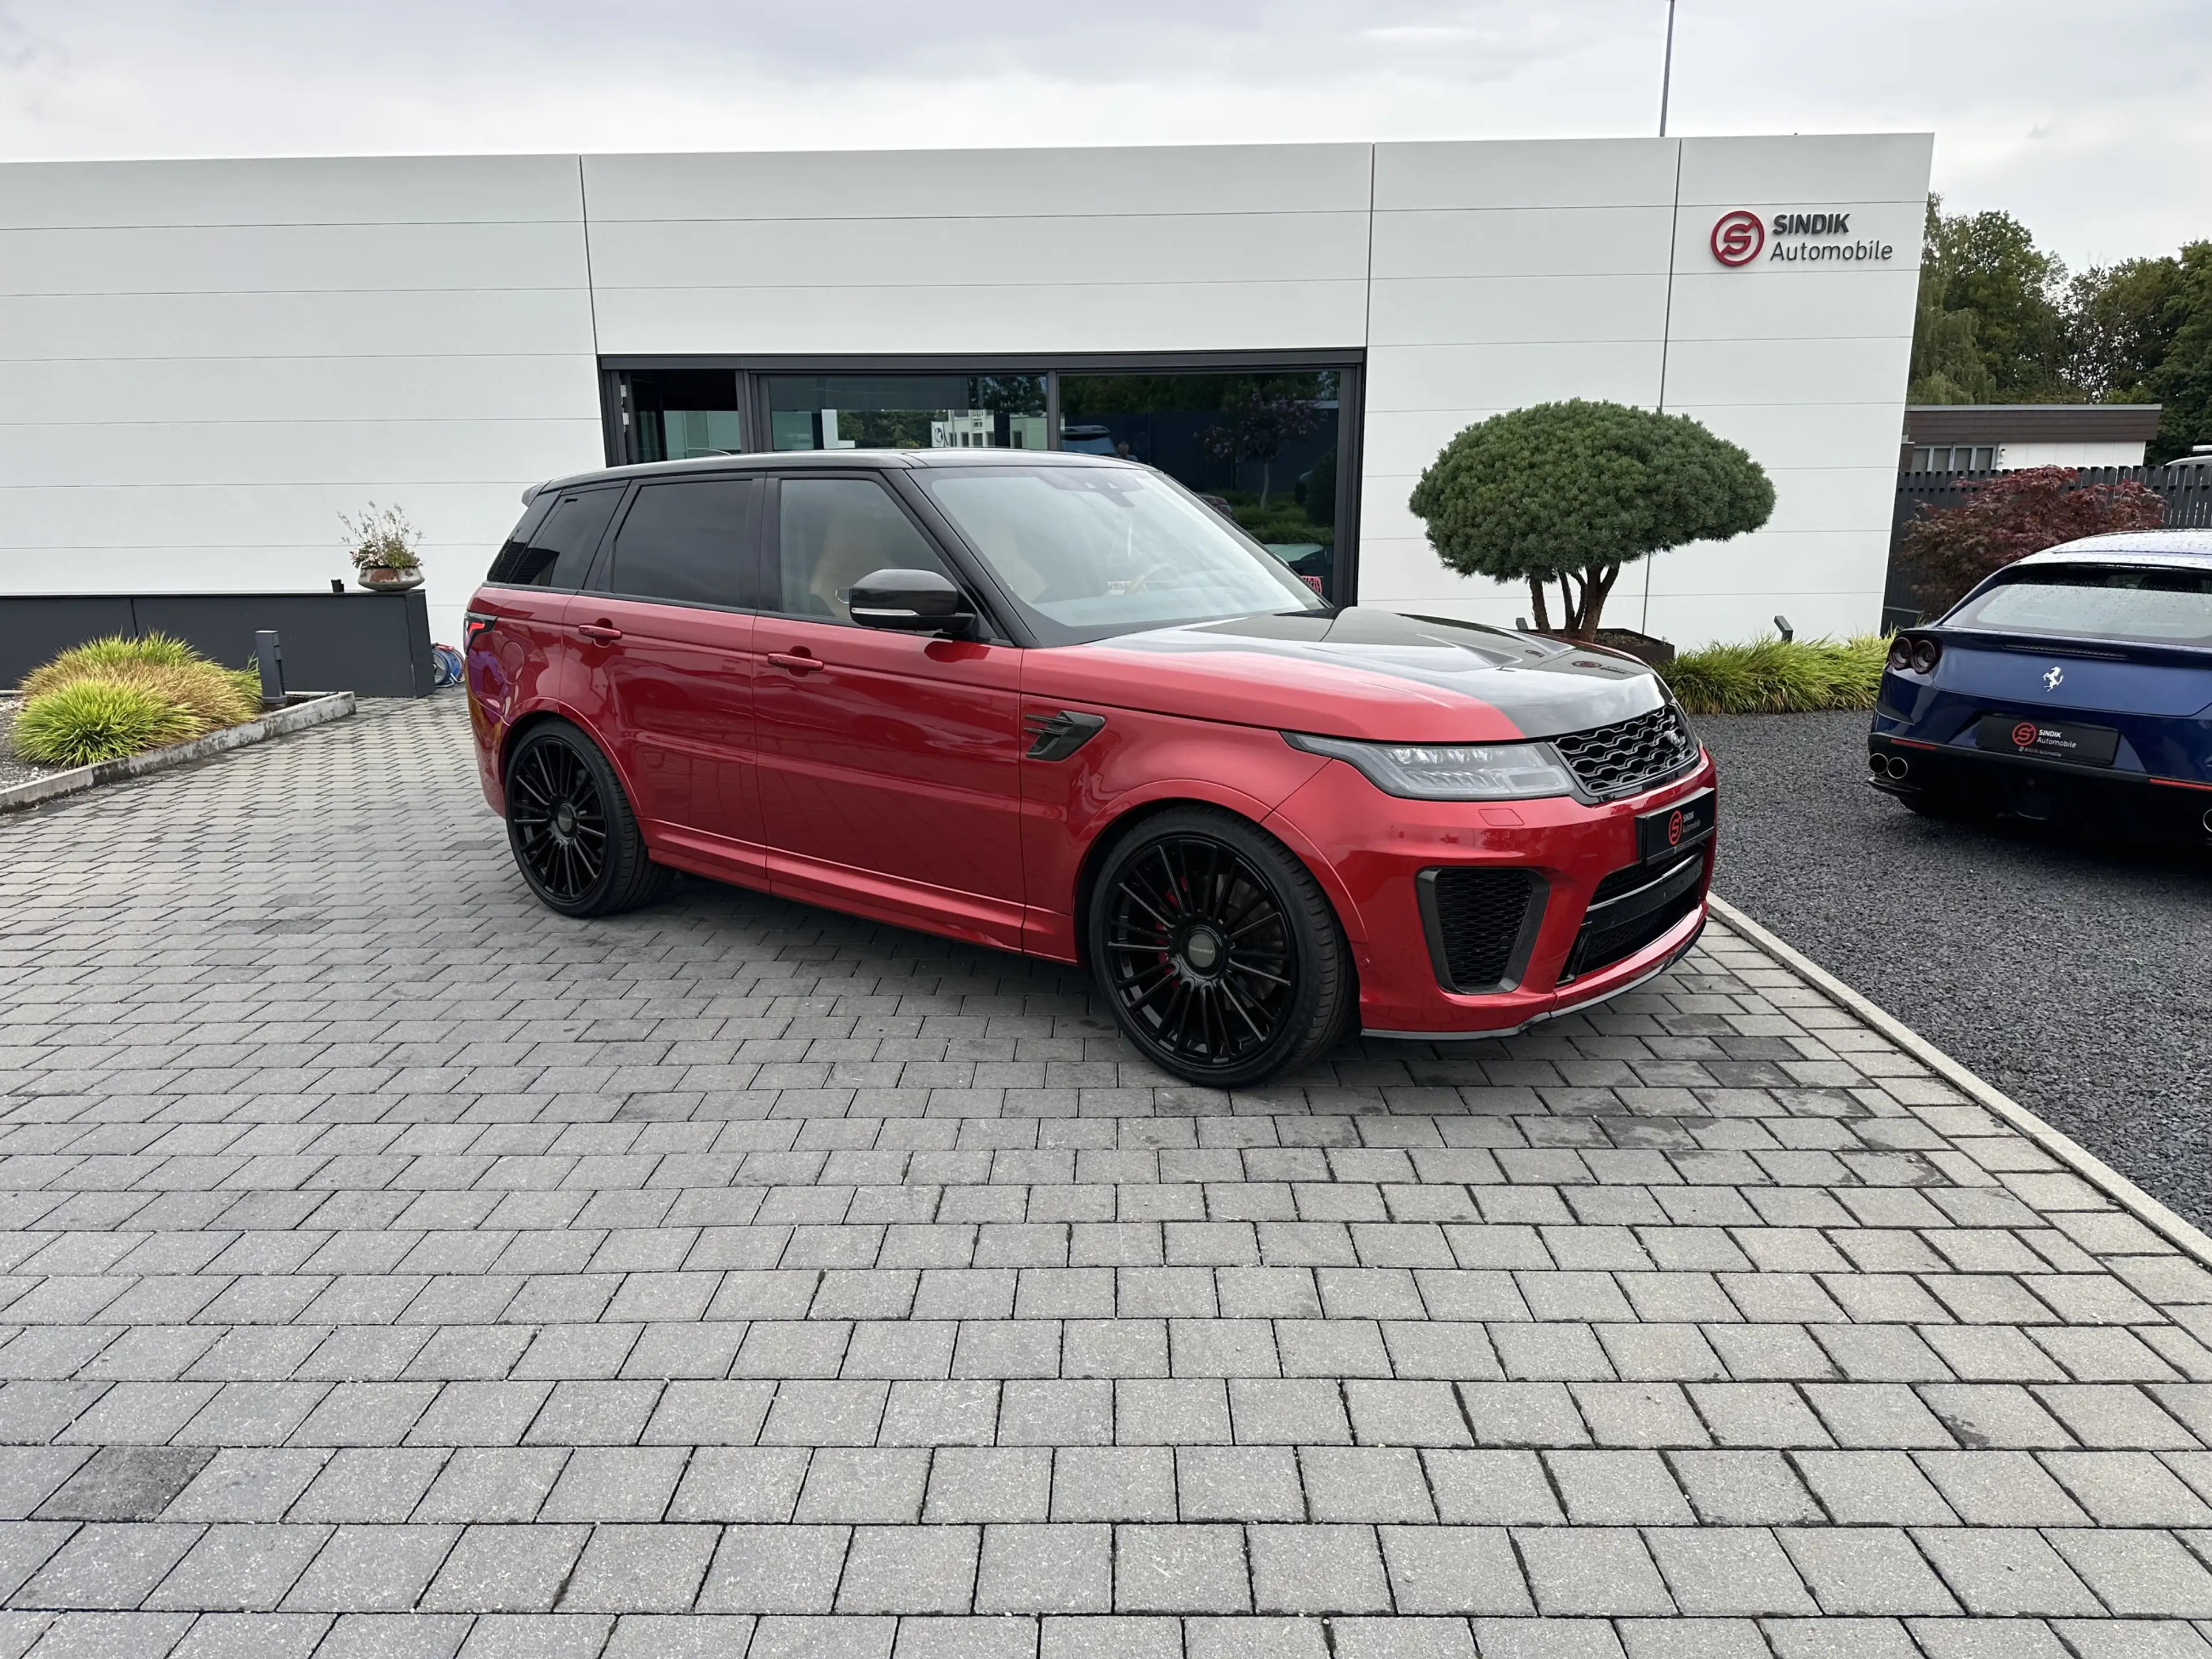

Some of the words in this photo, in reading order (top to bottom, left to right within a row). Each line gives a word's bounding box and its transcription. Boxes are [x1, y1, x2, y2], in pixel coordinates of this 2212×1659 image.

[1772, 214, 1850, 234] SINDIK
[1770, 240, 1893, 261] Automobile
[2039, 729, 2061, 738] SINDIK
[2036, 736, 2077, 748] Automobile
